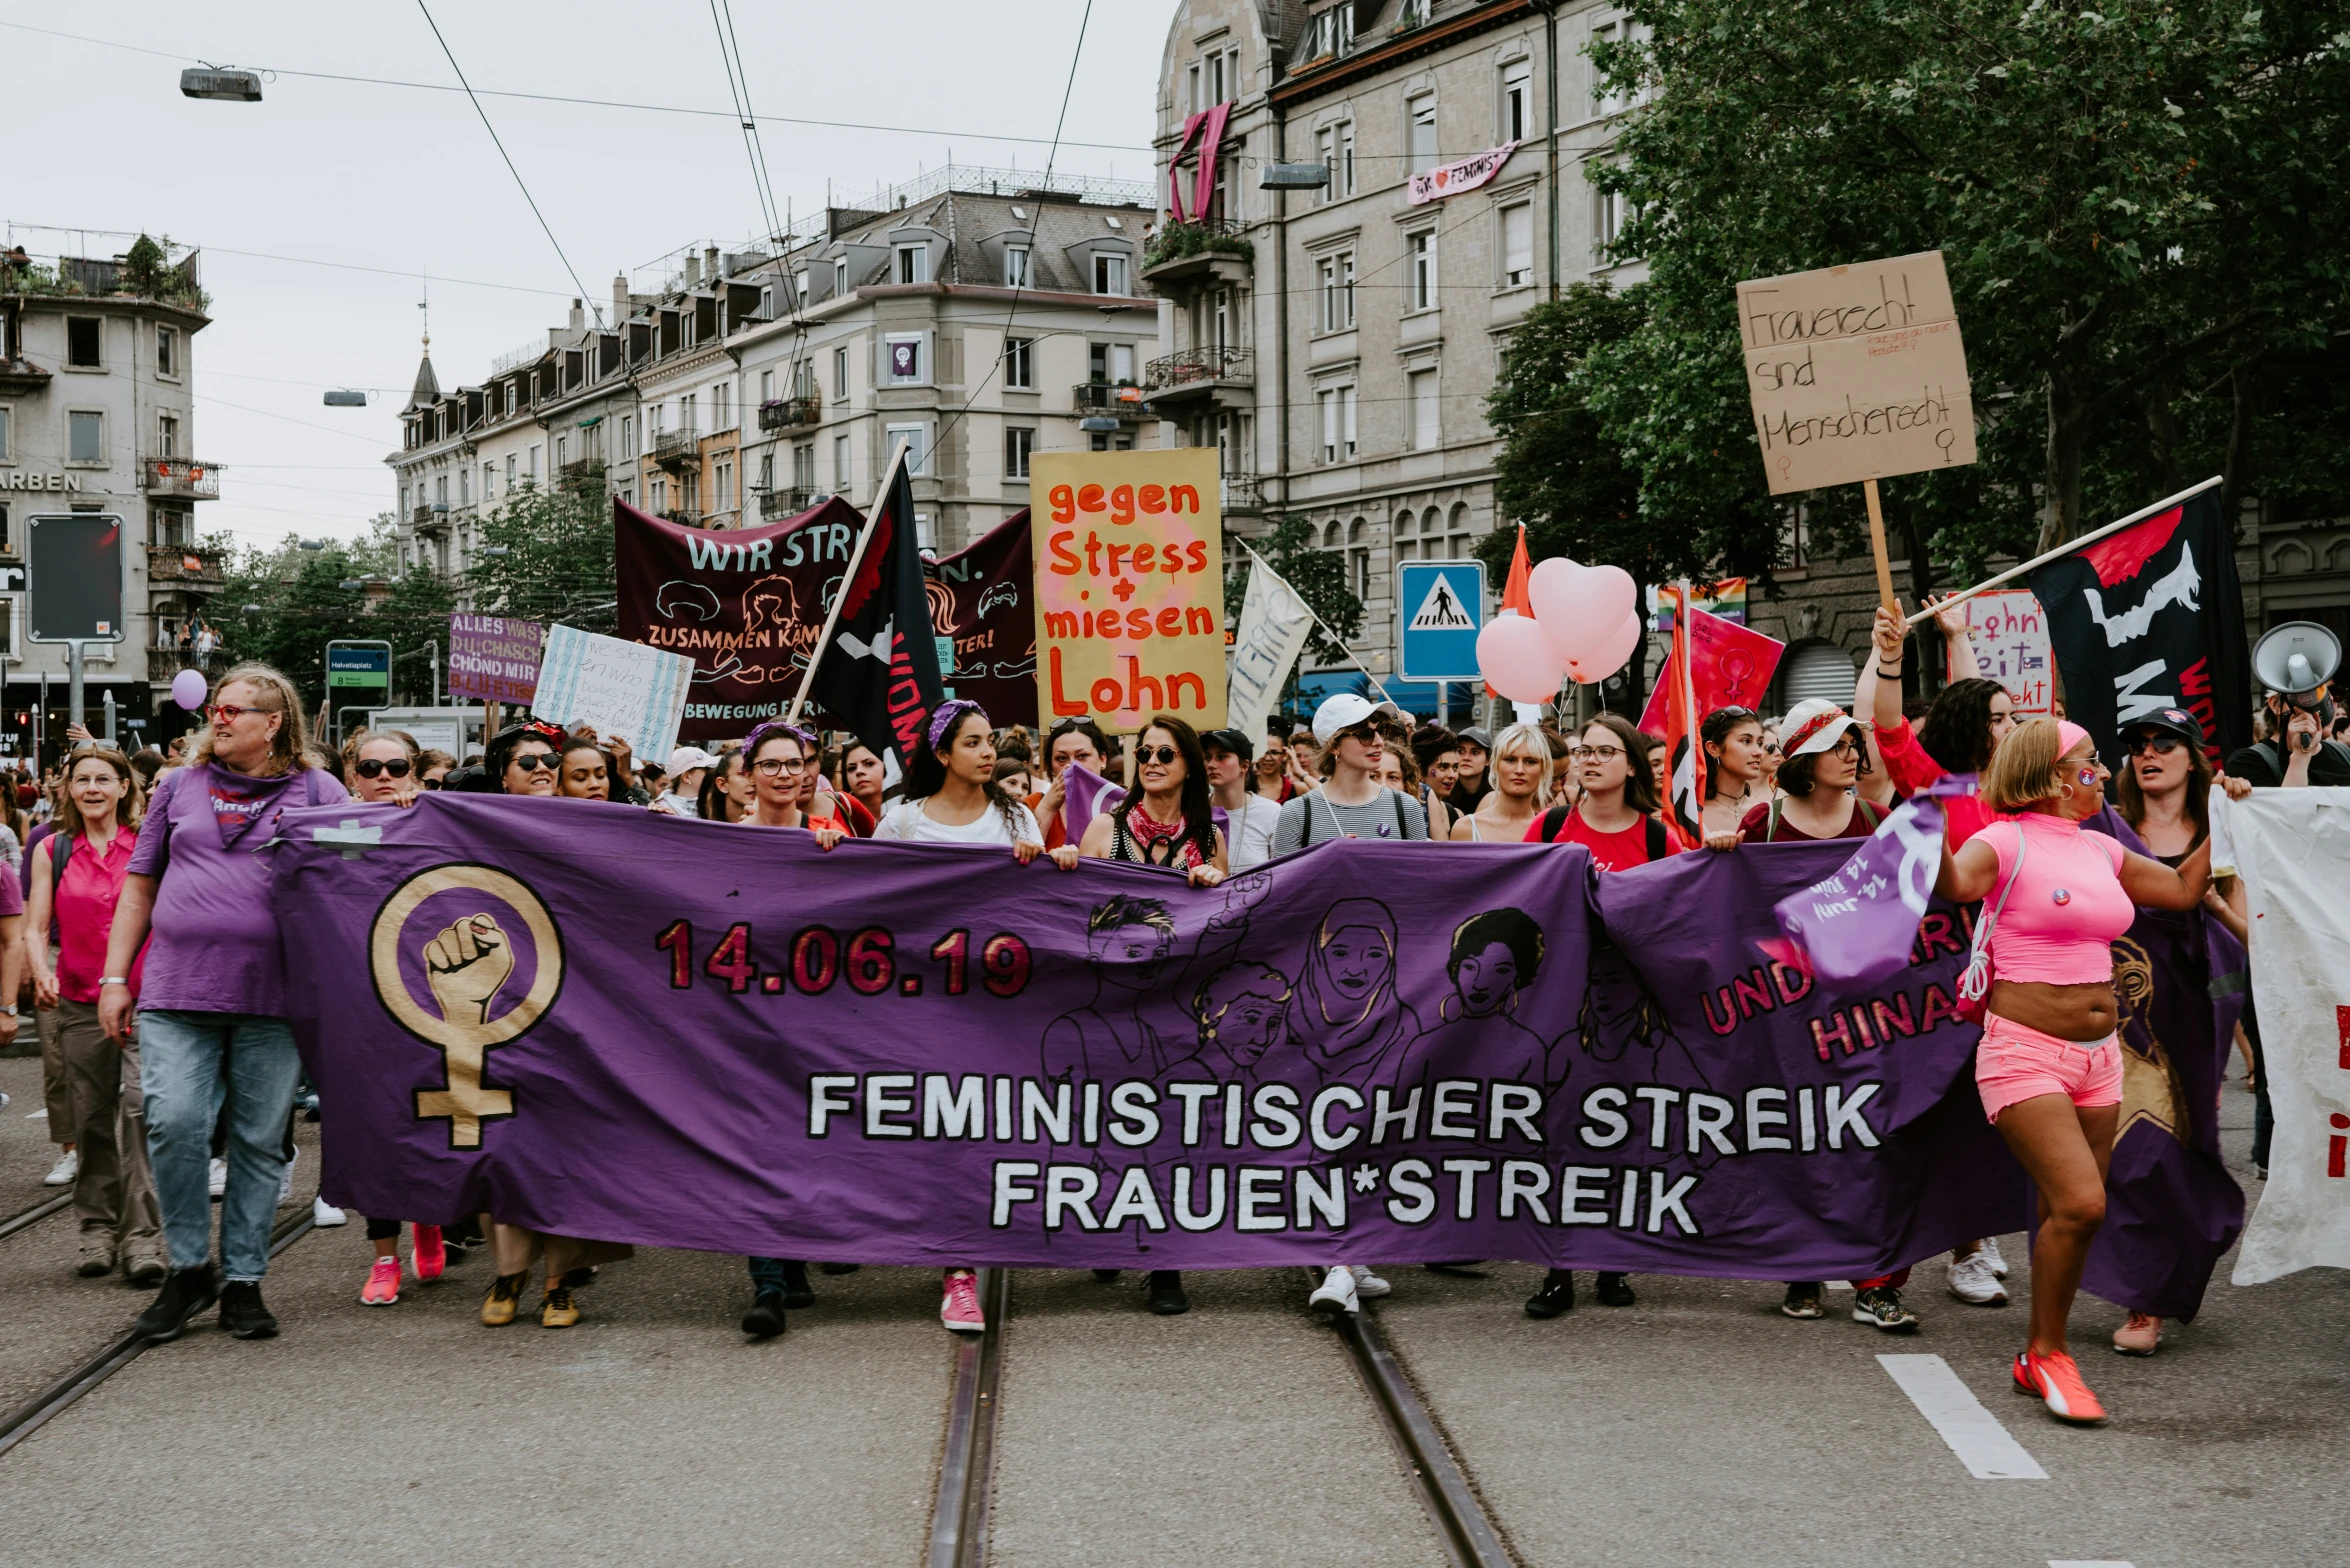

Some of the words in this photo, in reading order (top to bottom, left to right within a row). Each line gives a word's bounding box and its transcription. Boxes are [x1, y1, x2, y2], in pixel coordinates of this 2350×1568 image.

[1744, 272, 1916, 345] Frauerecht
[1755, 345, 1816, 391] sind
[1762, 385, 1949, 450] Menscherecht
[1049, 484, 1199, 525] gegen
[685, 533, 773, 572] WIR
[1049, 531, 1207, 584] Stress
[452, 616, 503, 634] ALLES
[506, 621, 537, 641] WAS
[1043, 590, 1214, 640] miesen
[452, 636, 475, 653] DU
[481, 640, 541, 663] CHASCH
[649, 624, 771, 649] ZUSAMMEN
[778, 622, 824, 649] KÄM
[331, 661, 373, 669] Helvetiaplatz
[450, 652, 502, 676] CHÖND
[505, 662, 535, 681] MIR
[1972, 642, 2031, 676] eit
[337, 677, 344, 685] 8
[1050, 647, 1206, 718] Lohn
[2012, 681, 2046, 706] ekt
[684, 703, 777, 720] BEWEGUNG
[781, 698, 816, 716] FR
[210, 796, 267, 815] ARCH
[1846, 855, 1869, 881] 14
[655, 919, 1034, 998] 14.06.19
[1700, 958, 1815, 1038] UND
[1809, 983, 1966, 1063] HINA
[807, 1072, 1546, 1152] FEMINISTISCHER
[1579, 1081, 1882, 1157] STREIK
